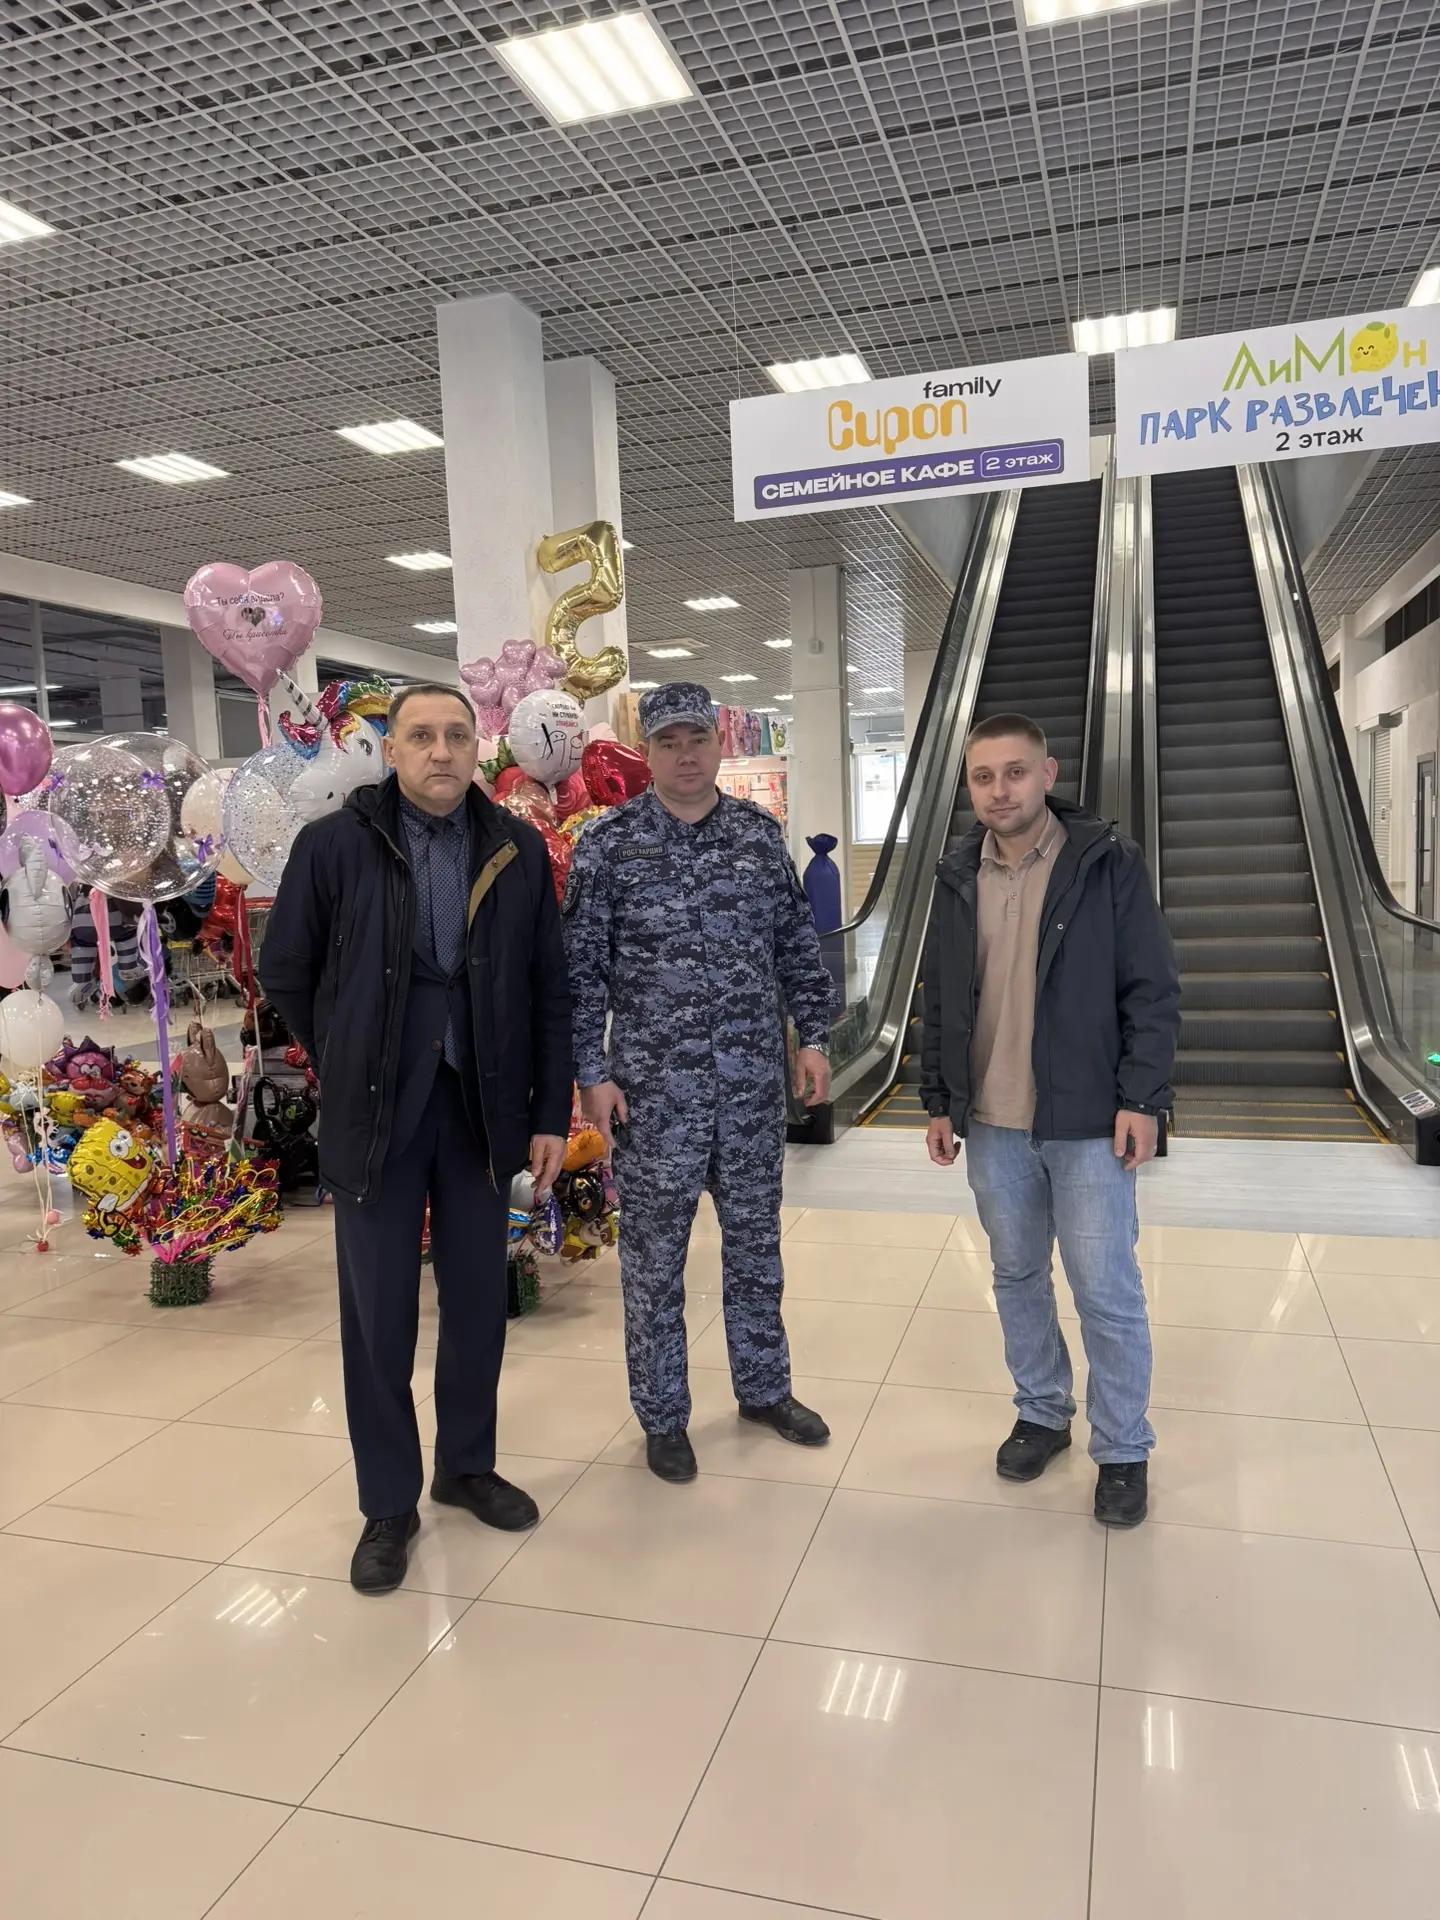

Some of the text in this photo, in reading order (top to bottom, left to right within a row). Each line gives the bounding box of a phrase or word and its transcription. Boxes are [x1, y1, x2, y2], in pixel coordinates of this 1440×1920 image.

[923, 376, 1002, 399] family
[1140, 397, 1232, 445] ПАРК
[1275, 427, 1364, 452] 2 этаж
[985, 452, 1054, 471] 2 этаж
[761, 459, 975, 501] СЕМЕЙНОЕ КАФЕ
